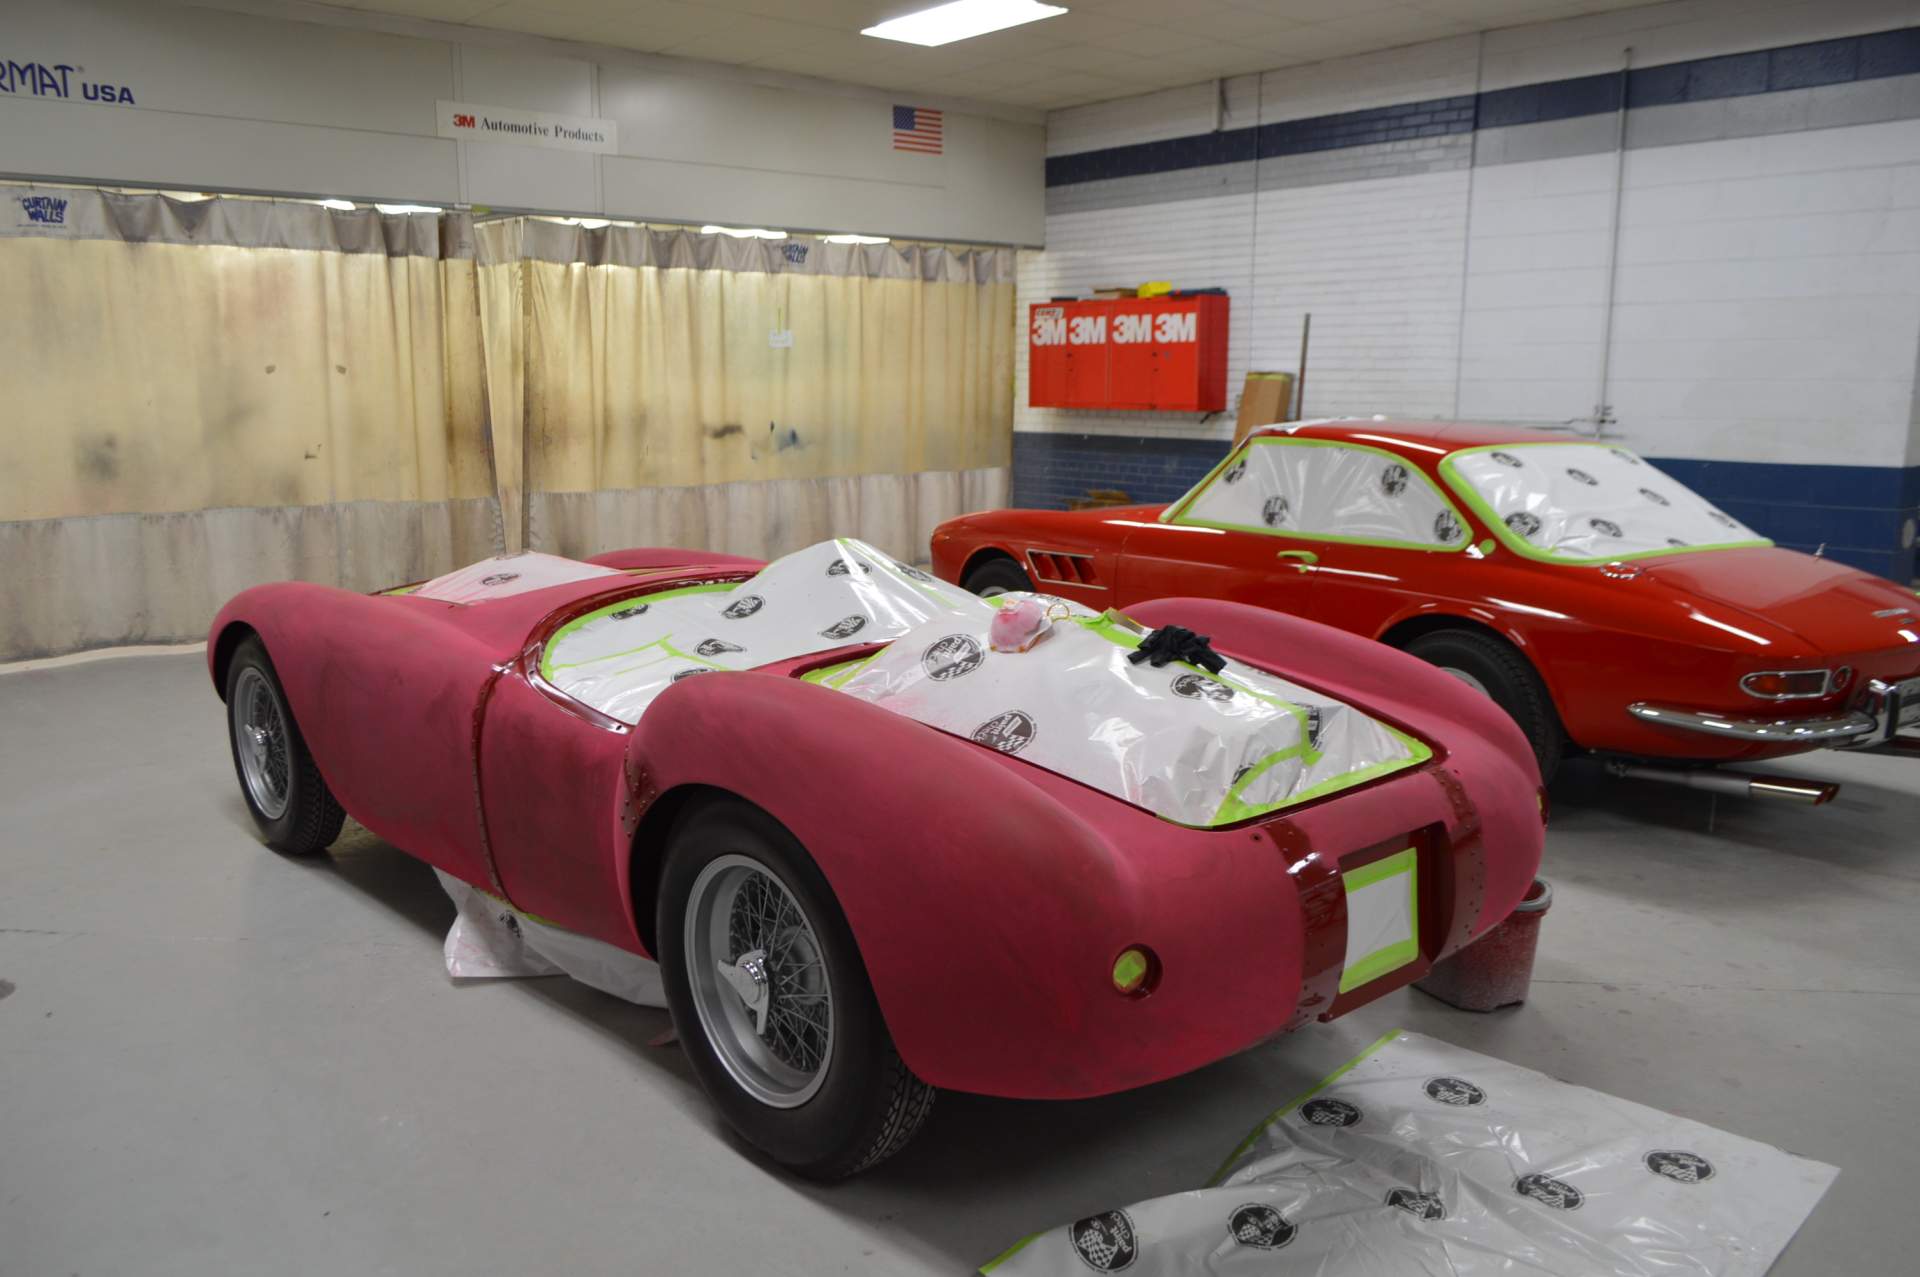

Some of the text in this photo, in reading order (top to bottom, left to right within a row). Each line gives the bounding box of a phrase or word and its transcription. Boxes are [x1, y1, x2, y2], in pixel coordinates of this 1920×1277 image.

[82, 82, 135, 104] USA
[453, 114, 605, 143] 3M Automotive Products
[1032, 312, 1197, 346] 3M 3M 3M 3M
